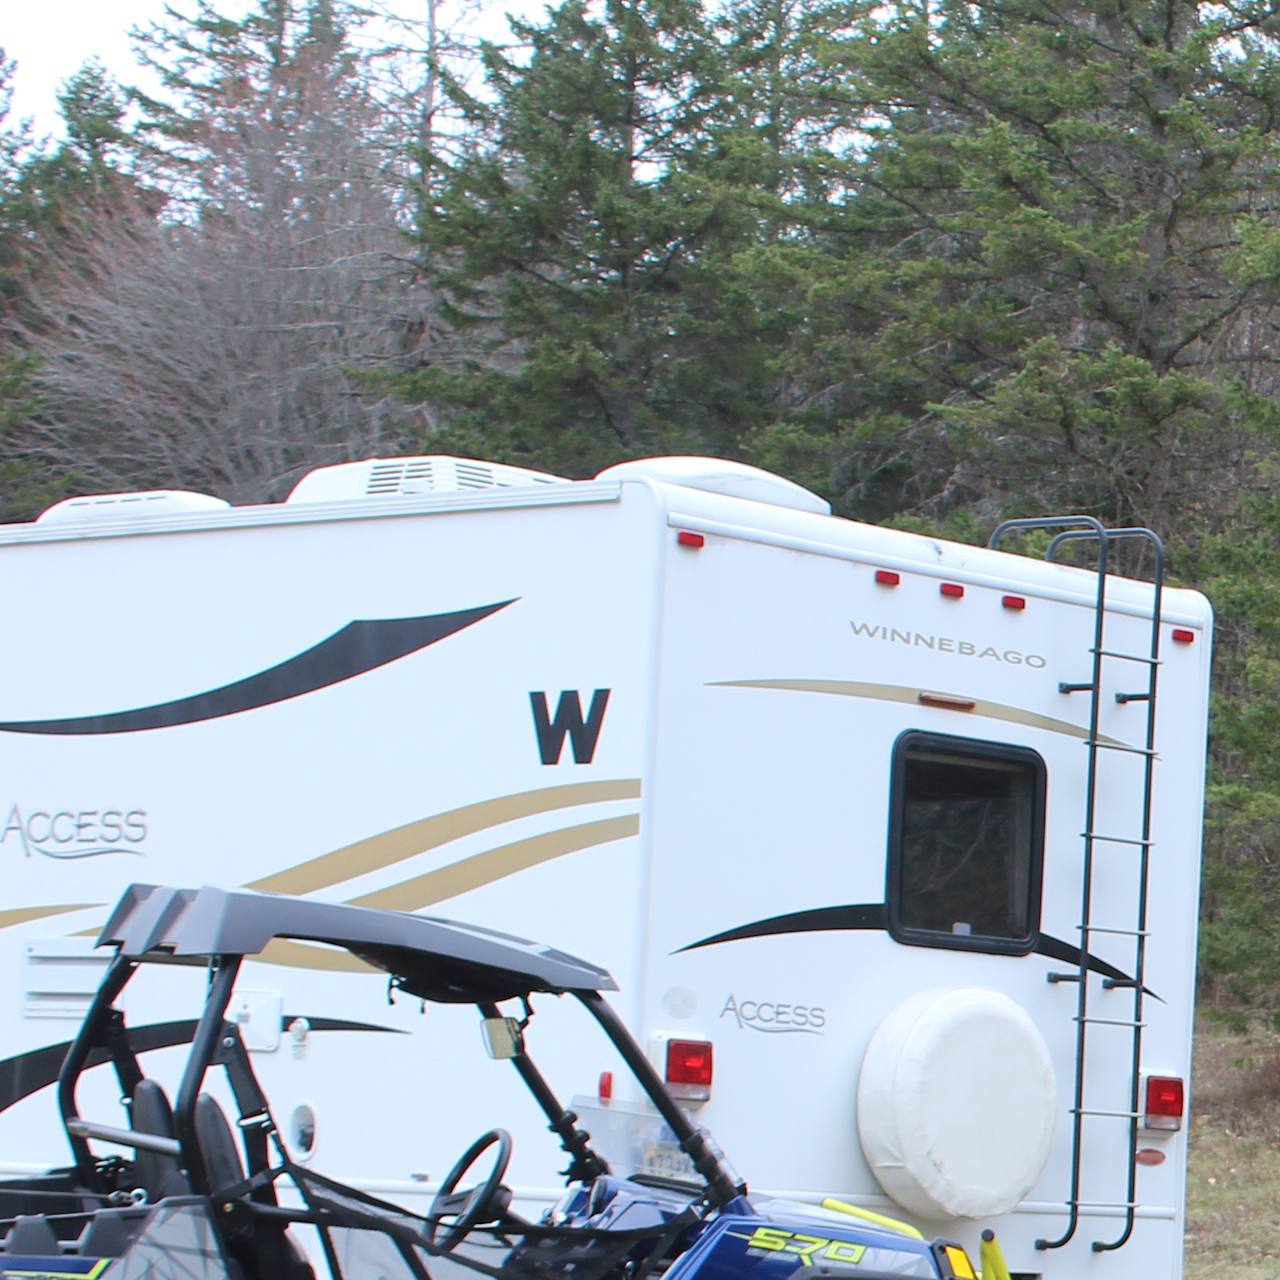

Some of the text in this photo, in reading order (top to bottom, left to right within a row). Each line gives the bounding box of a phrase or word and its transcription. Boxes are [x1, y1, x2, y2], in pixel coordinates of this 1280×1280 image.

[849, 620, 1048, 669] WINNEBAGO
[528, 687, 611, 765] W
[747, 1226, 867, 1267] 570
